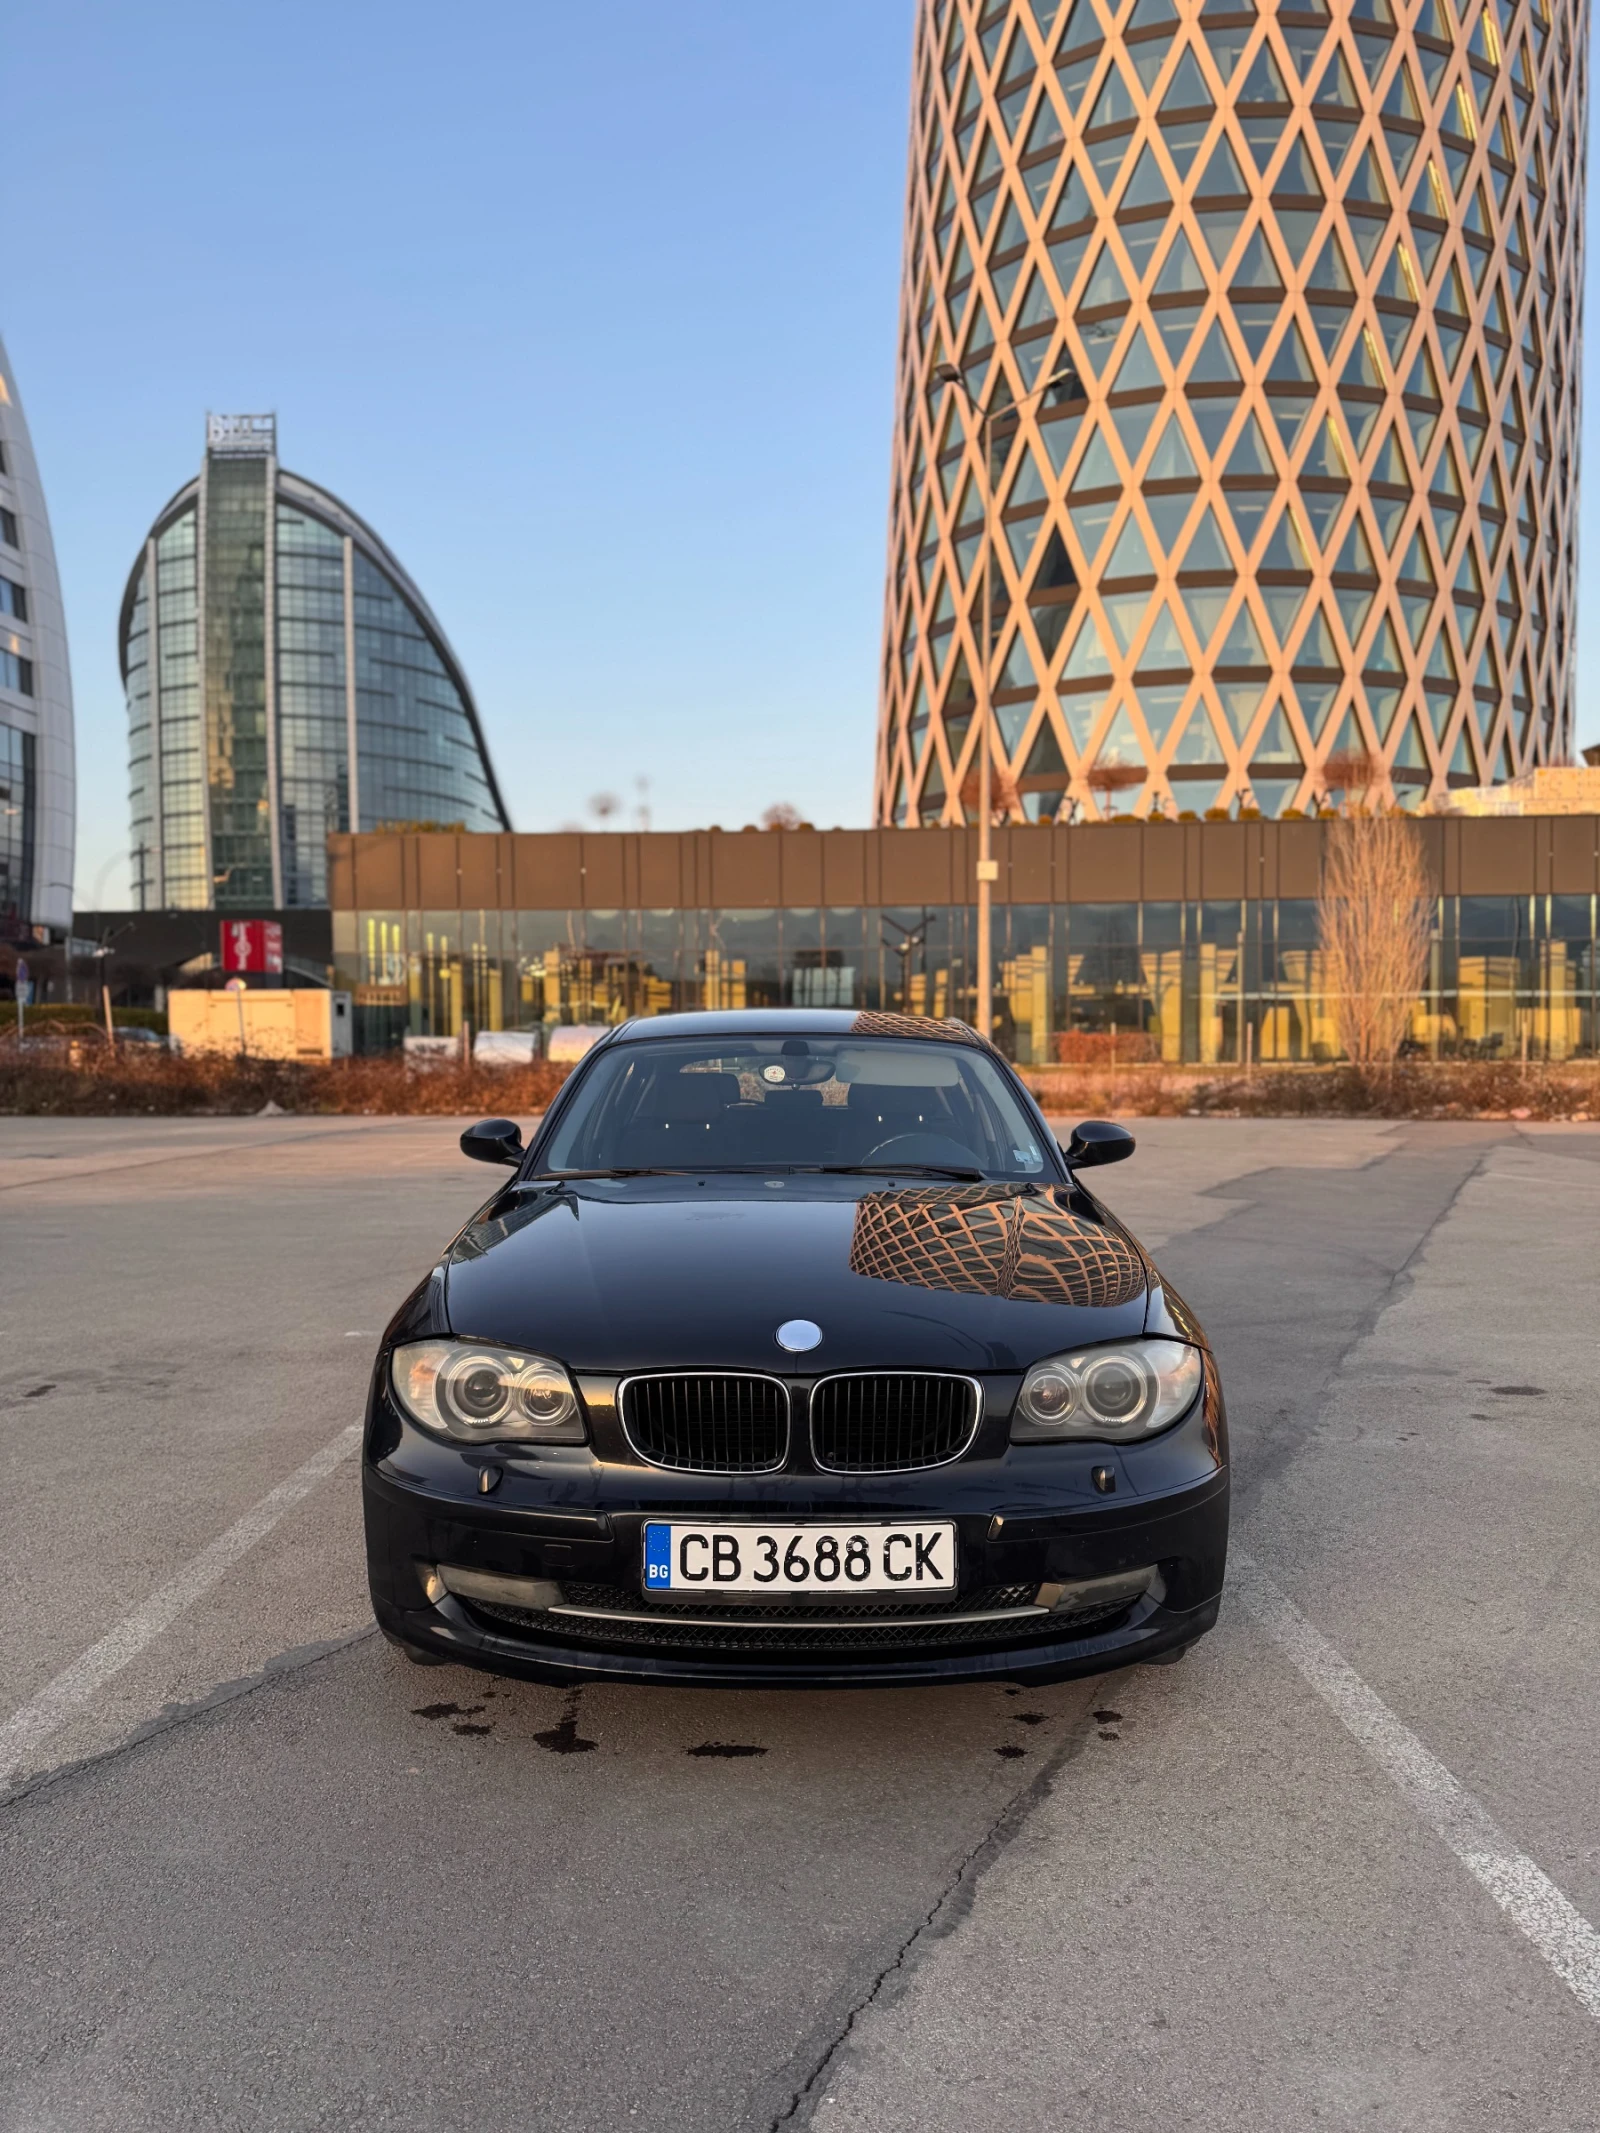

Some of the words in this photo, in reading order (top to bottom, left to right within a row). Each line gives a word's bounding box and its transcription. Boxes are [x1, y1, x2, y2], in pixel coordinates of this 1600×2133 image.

[649, 1564, 669, 1578] BG
[680, 1533, 741, 1582] CB
[753, 1534, 871, 1583] 3688
[882, 1532, 944, 1581] CK
